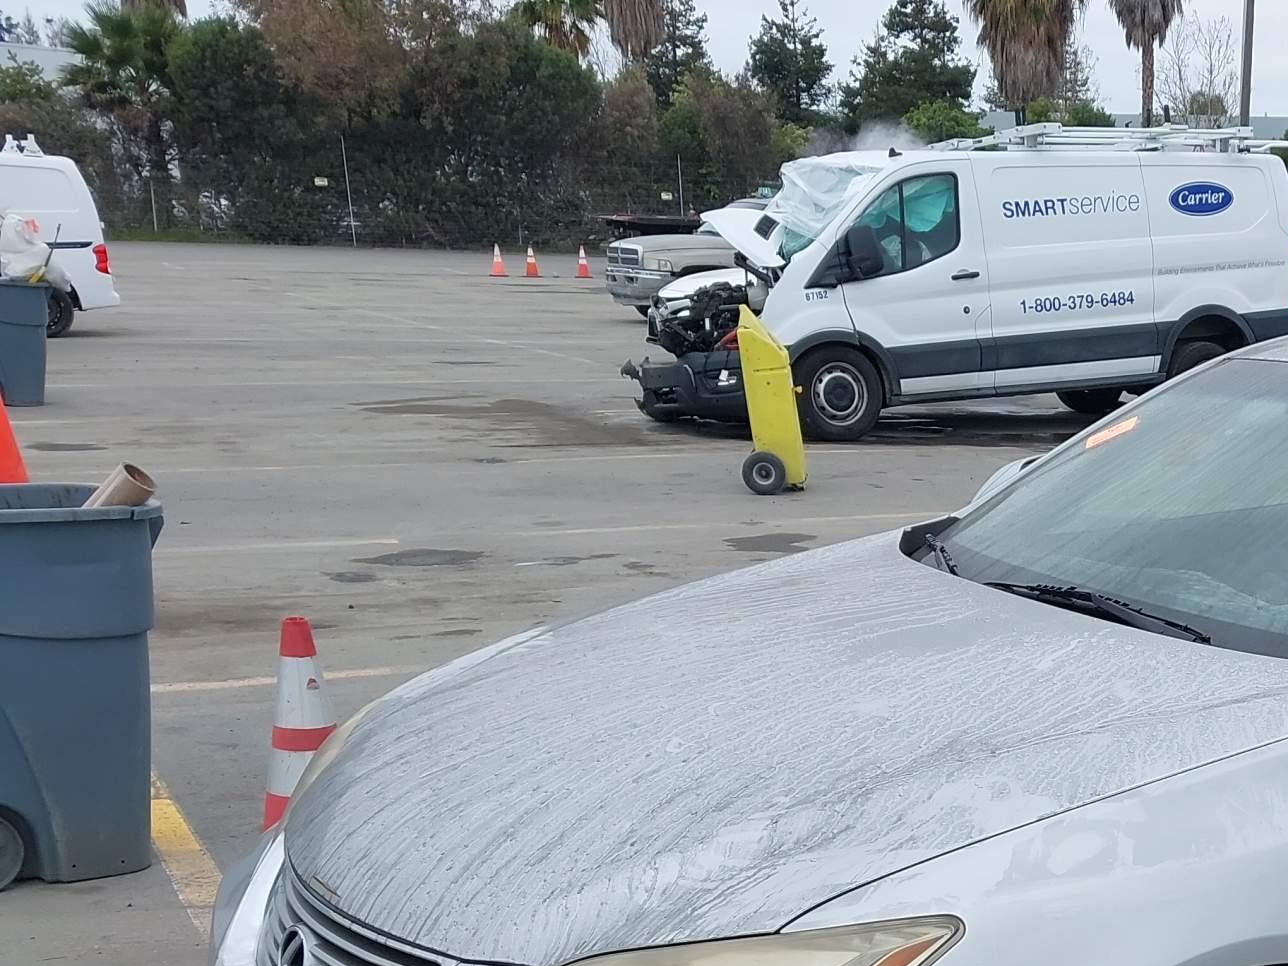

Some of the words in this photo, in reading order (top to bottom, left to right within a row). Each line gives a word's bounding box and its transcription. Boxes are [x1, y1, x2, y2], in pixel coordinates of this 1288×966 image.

[1001, 190, 1141, 219] SMARTservice
[1177, 188, 1226, 208] Carrier
[1019, 290, 1136, 315] 1-800-379-6484
